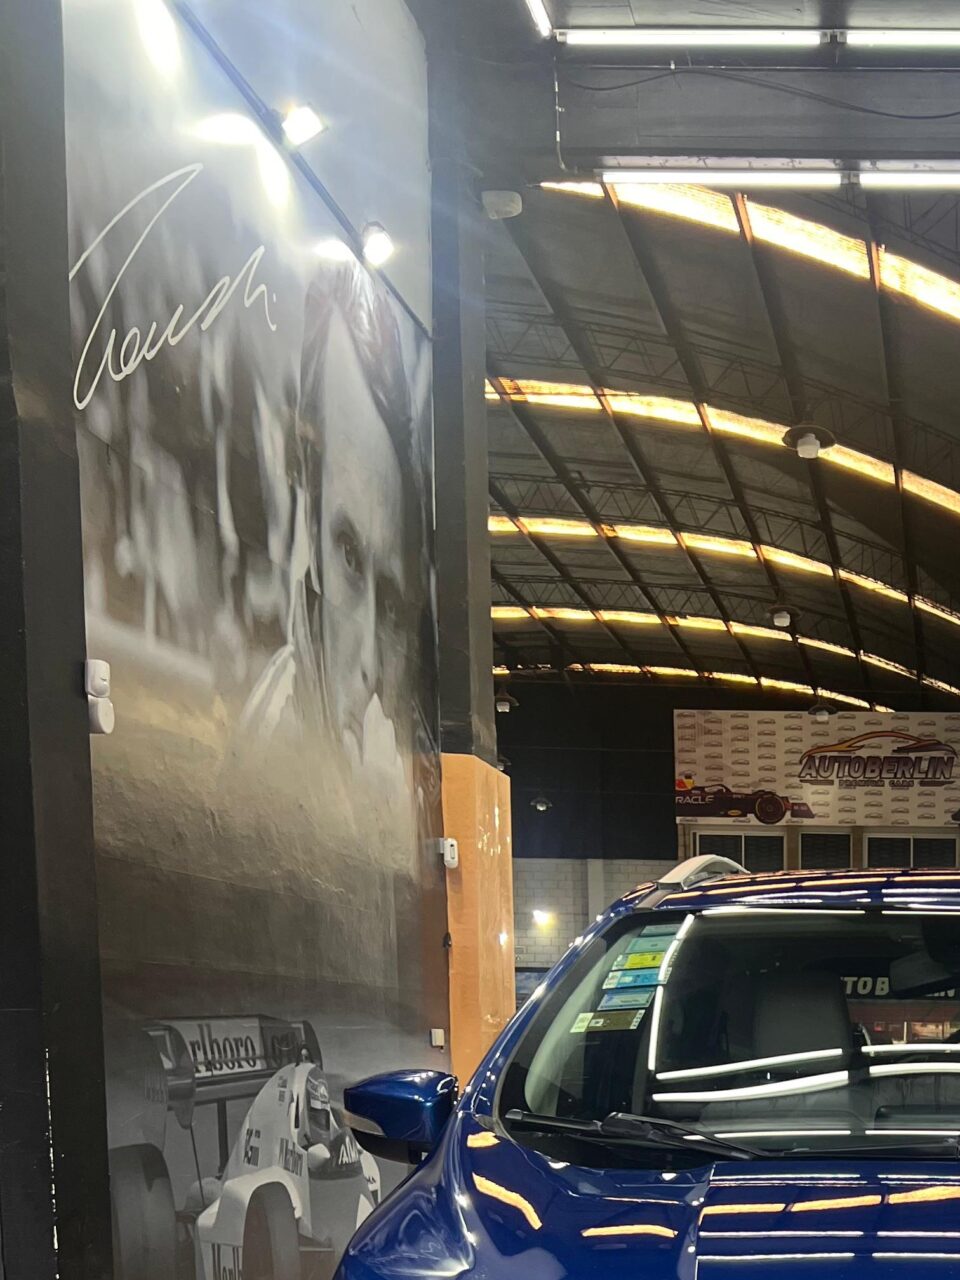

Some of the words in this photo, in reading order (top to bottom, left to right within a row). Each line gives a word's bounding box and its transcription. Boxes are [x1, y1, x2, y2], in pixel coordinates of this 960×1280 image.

[798, 755, 956, 780] AUTOBERLIN
[838, 780, 885, 788] PREMIUM
[889, 780, 915, 788] CARS
[675, 794, 715, 805] RACLE
[188, 1023, 257, 1072] rlboro
